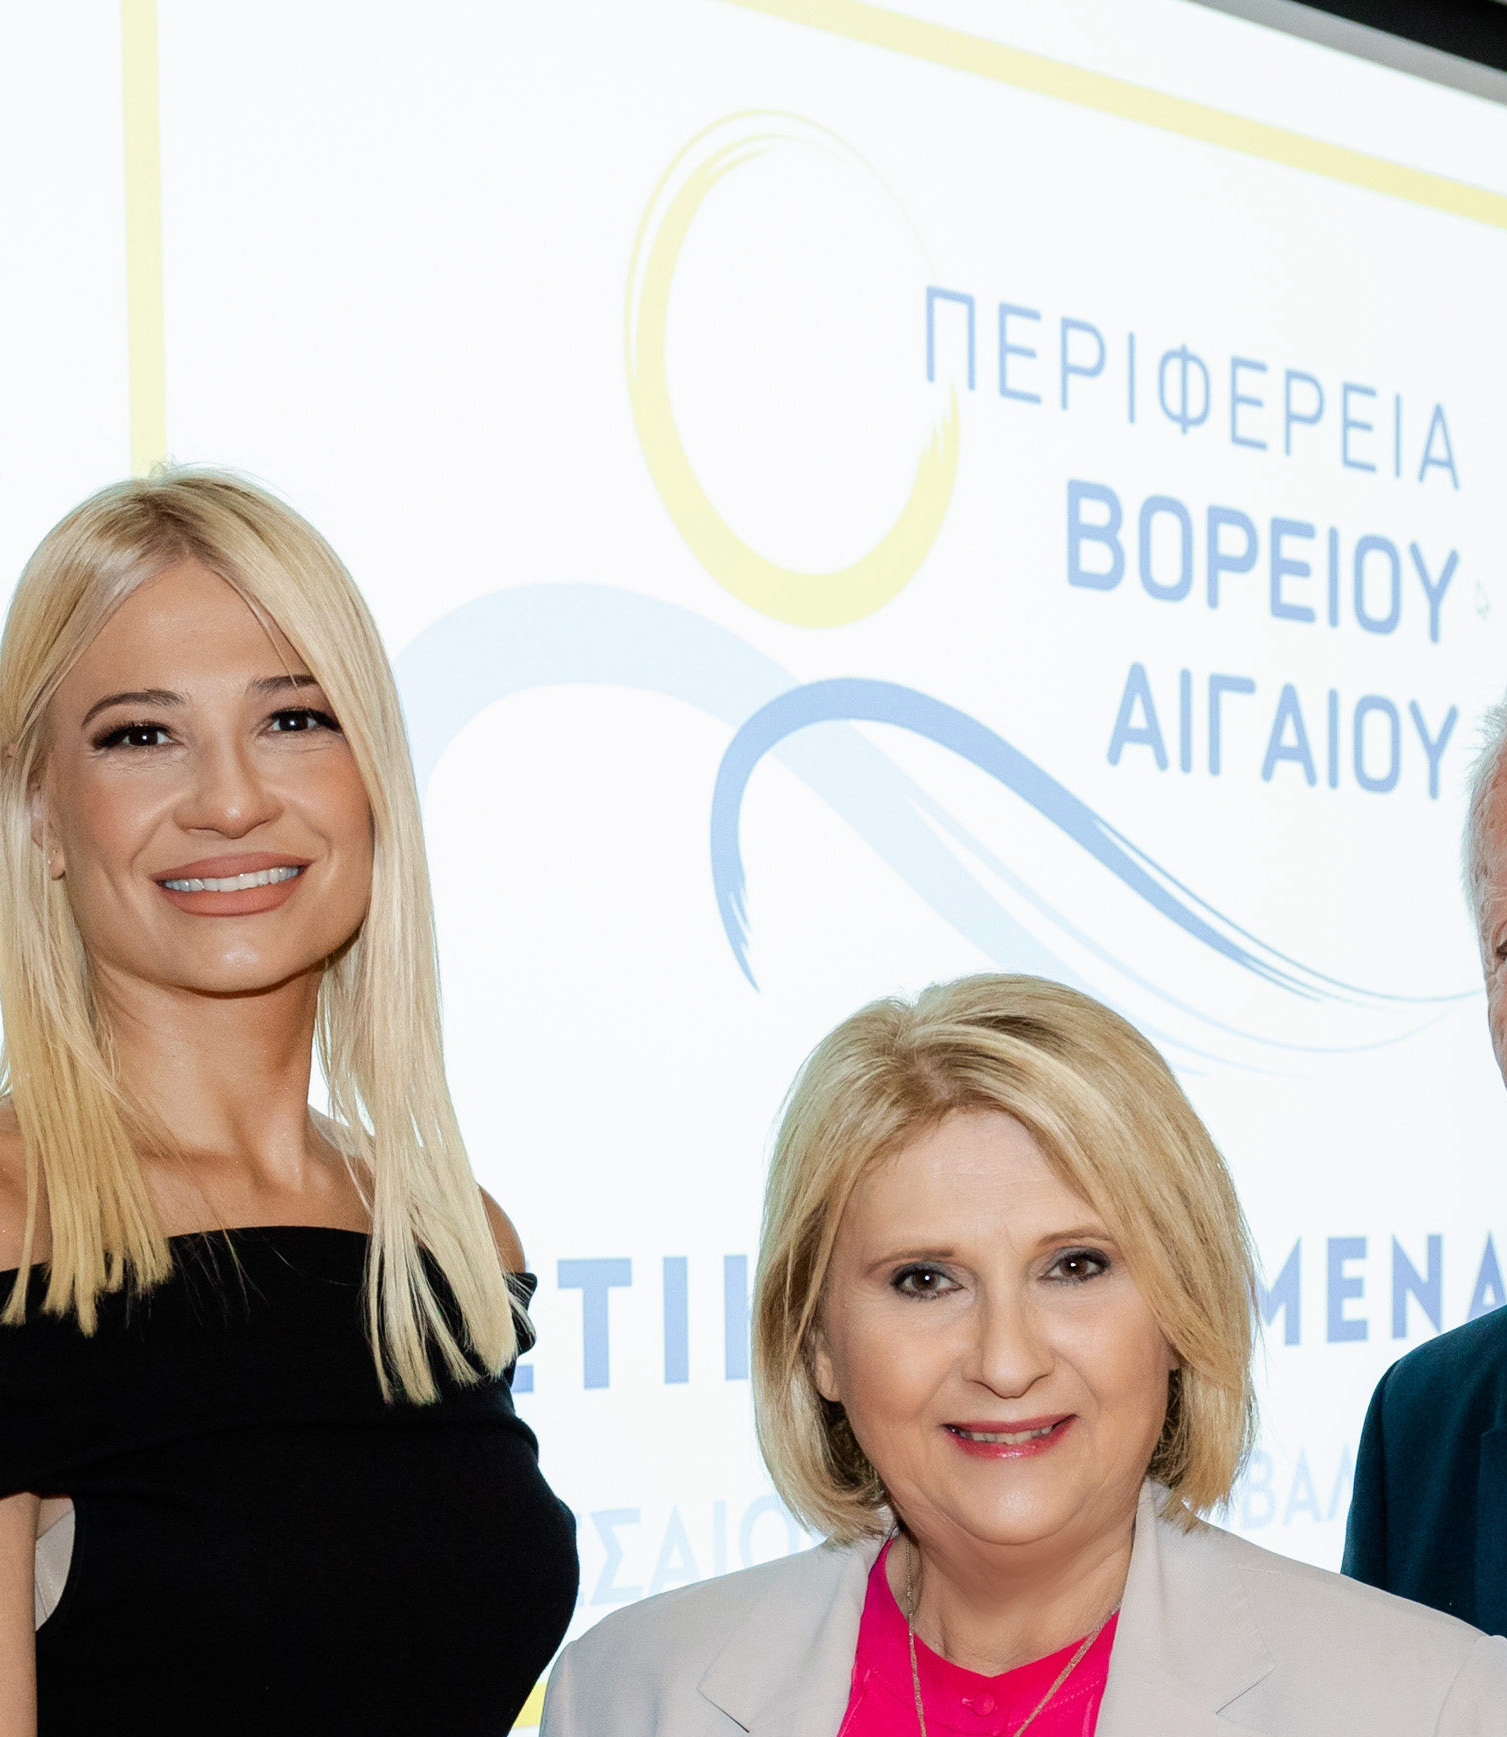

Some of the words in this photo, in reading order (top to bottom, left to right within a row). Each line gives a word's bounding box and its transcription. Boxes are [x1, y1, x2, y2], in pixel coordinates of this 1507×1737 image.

[925, 285, 1461, 491] ΠΕΡΙΦΕΡΕΙΑ
[1066, 478, 1461, 645] ΒΟΡΕΙΟΥ
[1106, 661, 1460, 801] ΑΙΓΑΙΟΥ
[1251, 1231, 1507, 1346] ΜΕΝΑ
